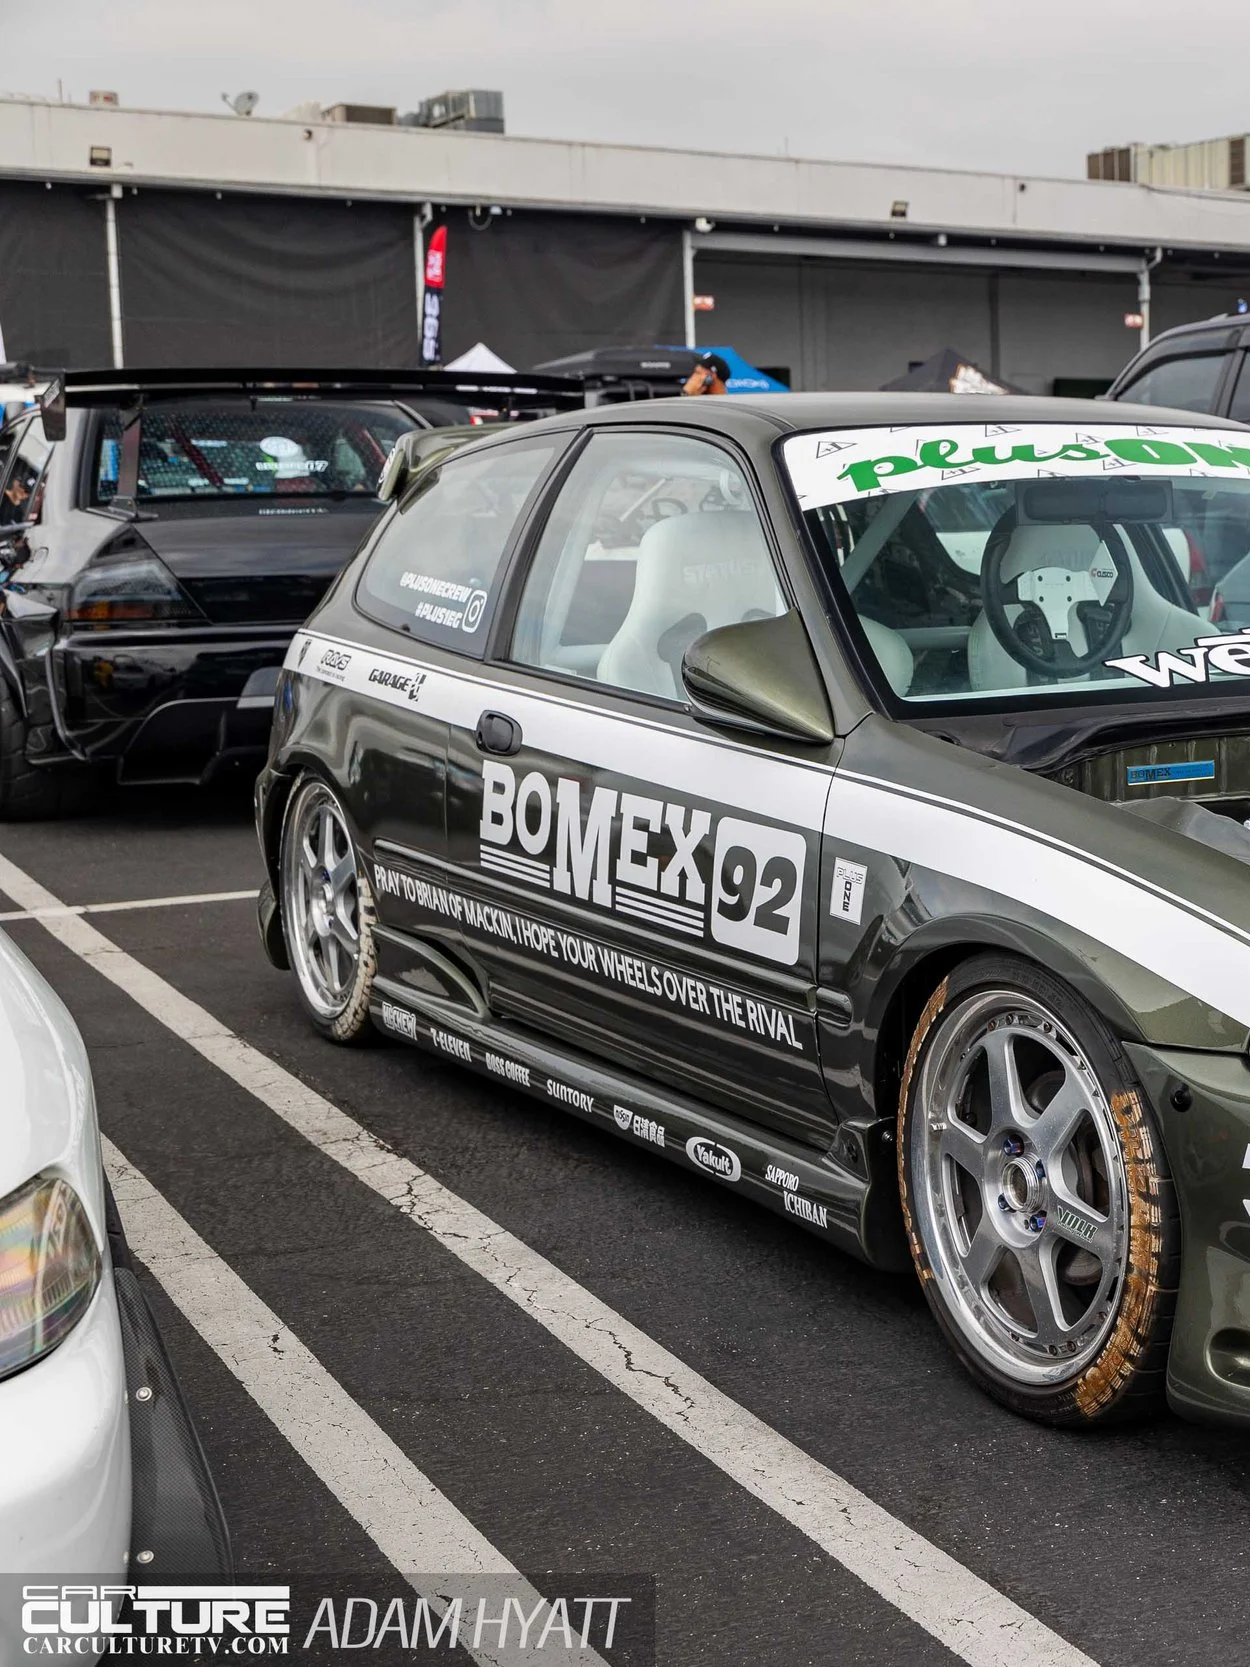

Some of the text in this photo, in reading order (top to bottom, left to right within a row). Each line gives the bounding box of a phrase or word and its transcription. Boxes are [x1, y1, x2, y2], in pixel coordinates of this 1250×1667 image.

[320, 649, 352, 671] RAYS
[368, 668, 412, 692] GARAGE
[1130, 767, 1172, 780] BOMEX
[480, 759, 711, 908] BOMEX
[716, 845, 798, 936] 92
[842, 880, 853, 912] ONE
[374, 864, 401, 896] PRAY
[401, 875, 416, 902] TO
[415, 879, 450, 916] BRIAN
[449, 893, 463, 921] OF
[463, 898, 518, 945] MACKIN,
[522, 918, 559, 958] HOPE
[558, 932, 599, 973] YOUR
[598, 946, 663, 996] WHEELS
[663, 970, 711, 1015] OVER
[709, 986, 746, 1029] THE
[746, 997, 803, 1050] RIVAL
[485, 1052, 531, 1087] BOSS COFFEE
[696, 1144, 731, 1175] Yakult
[765, 1164, 799, 1192] SAPPORO
[783, 1190, 828, 1229] ICHIBAN
